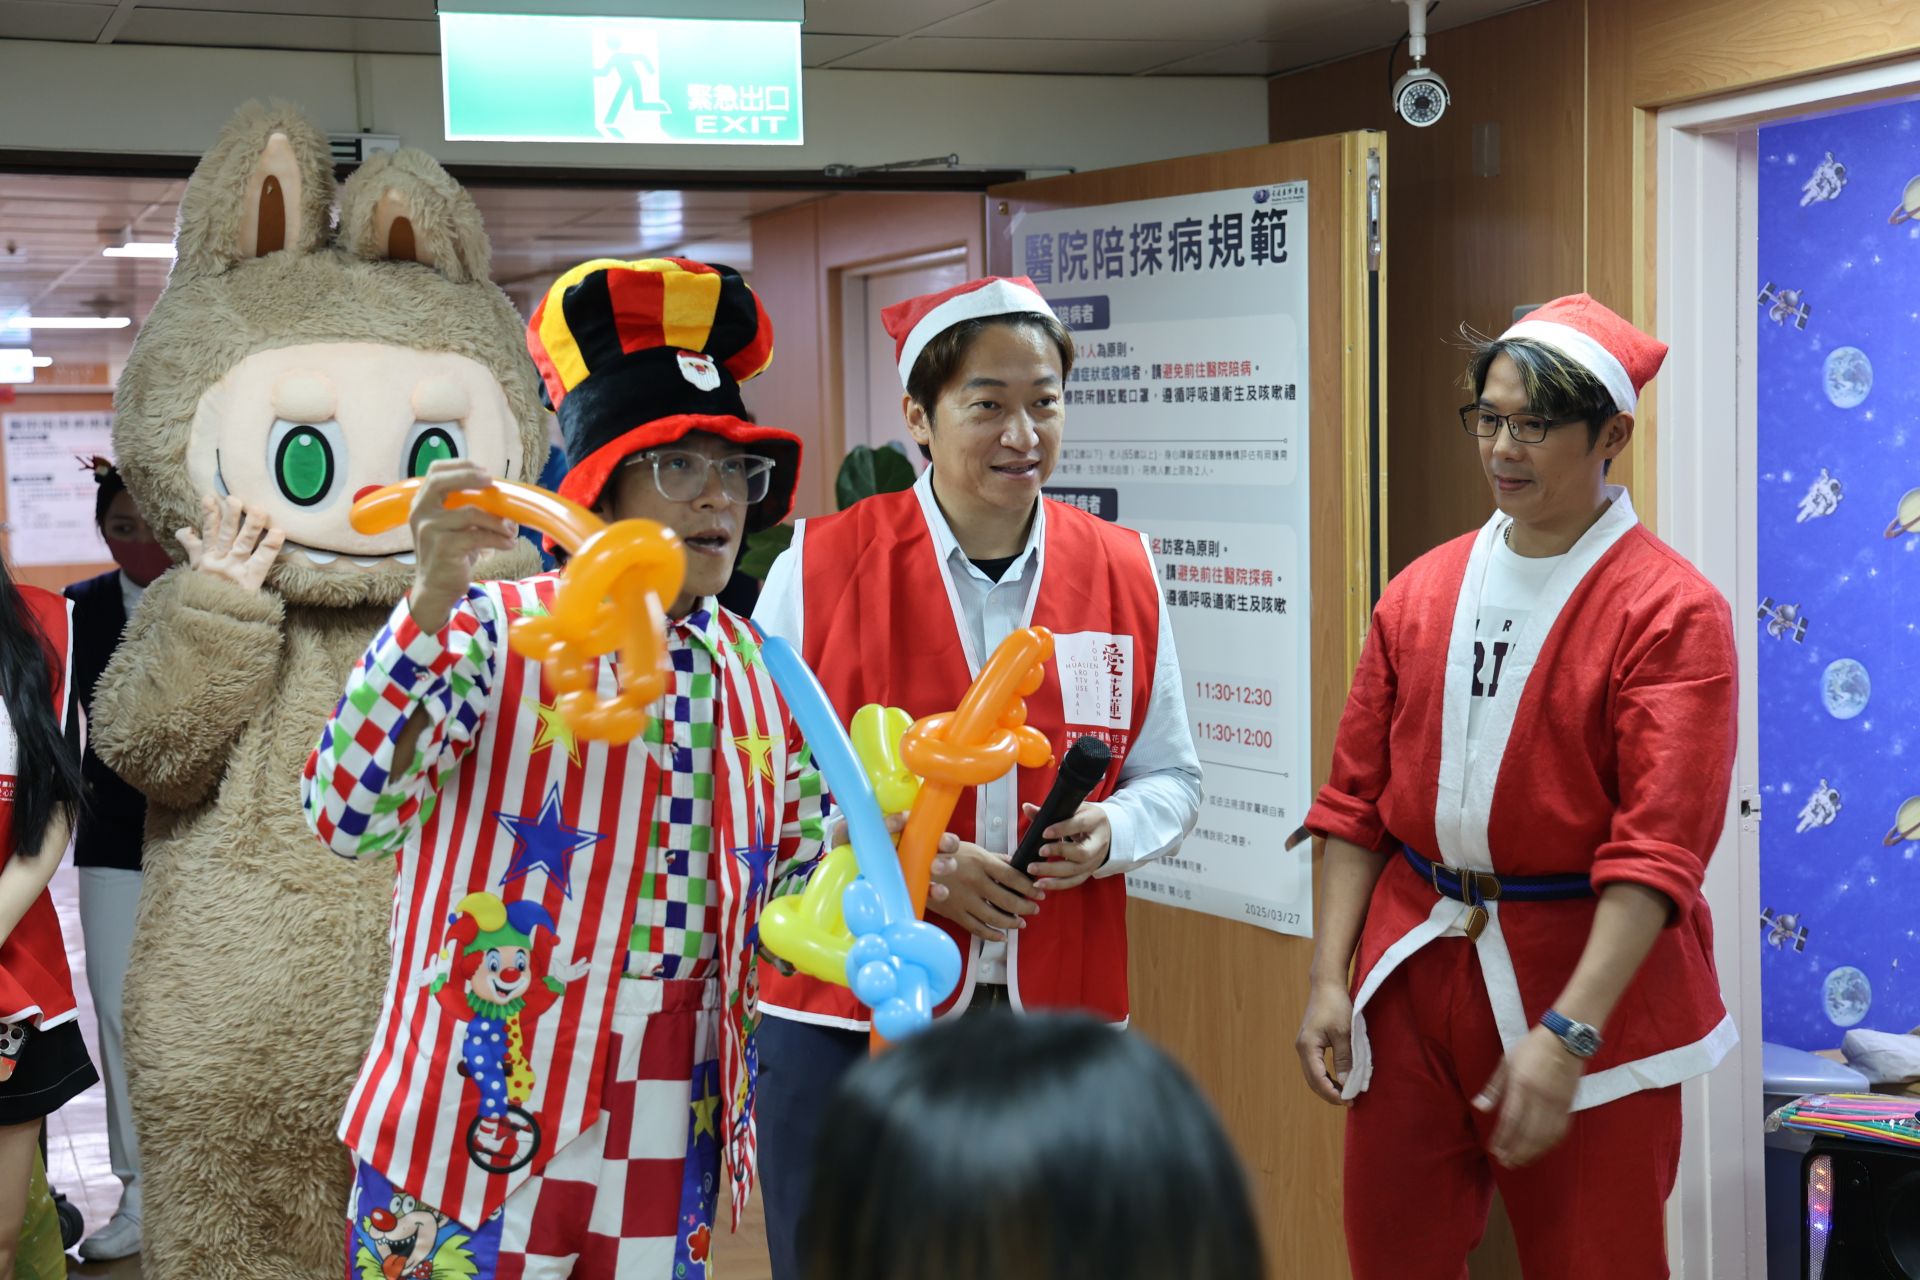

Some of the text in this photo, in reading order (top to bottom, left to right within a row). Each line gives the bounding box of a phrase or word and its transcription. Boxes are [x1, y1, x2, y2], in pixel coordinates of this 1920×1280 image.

[687, 84, 790, 112] 緊急出口
[695, 116, 787, 134] EXIT
[1024, 208, 1288, 284] 醫院陪探病規範
[1053, 304, 1094, 325] 陪病者
[1151, 538, 1228, 558] 名訪客為原則。
[1166, 589, 1288, 614] 遵循呼吸道衛生及咳嗽
[1196, 681, 1272, 707] 11:30-12:30
[1197, 722, 1273, 749] 11:30-12:00
[1245, 903, 1300, 925] 2025/03/27
